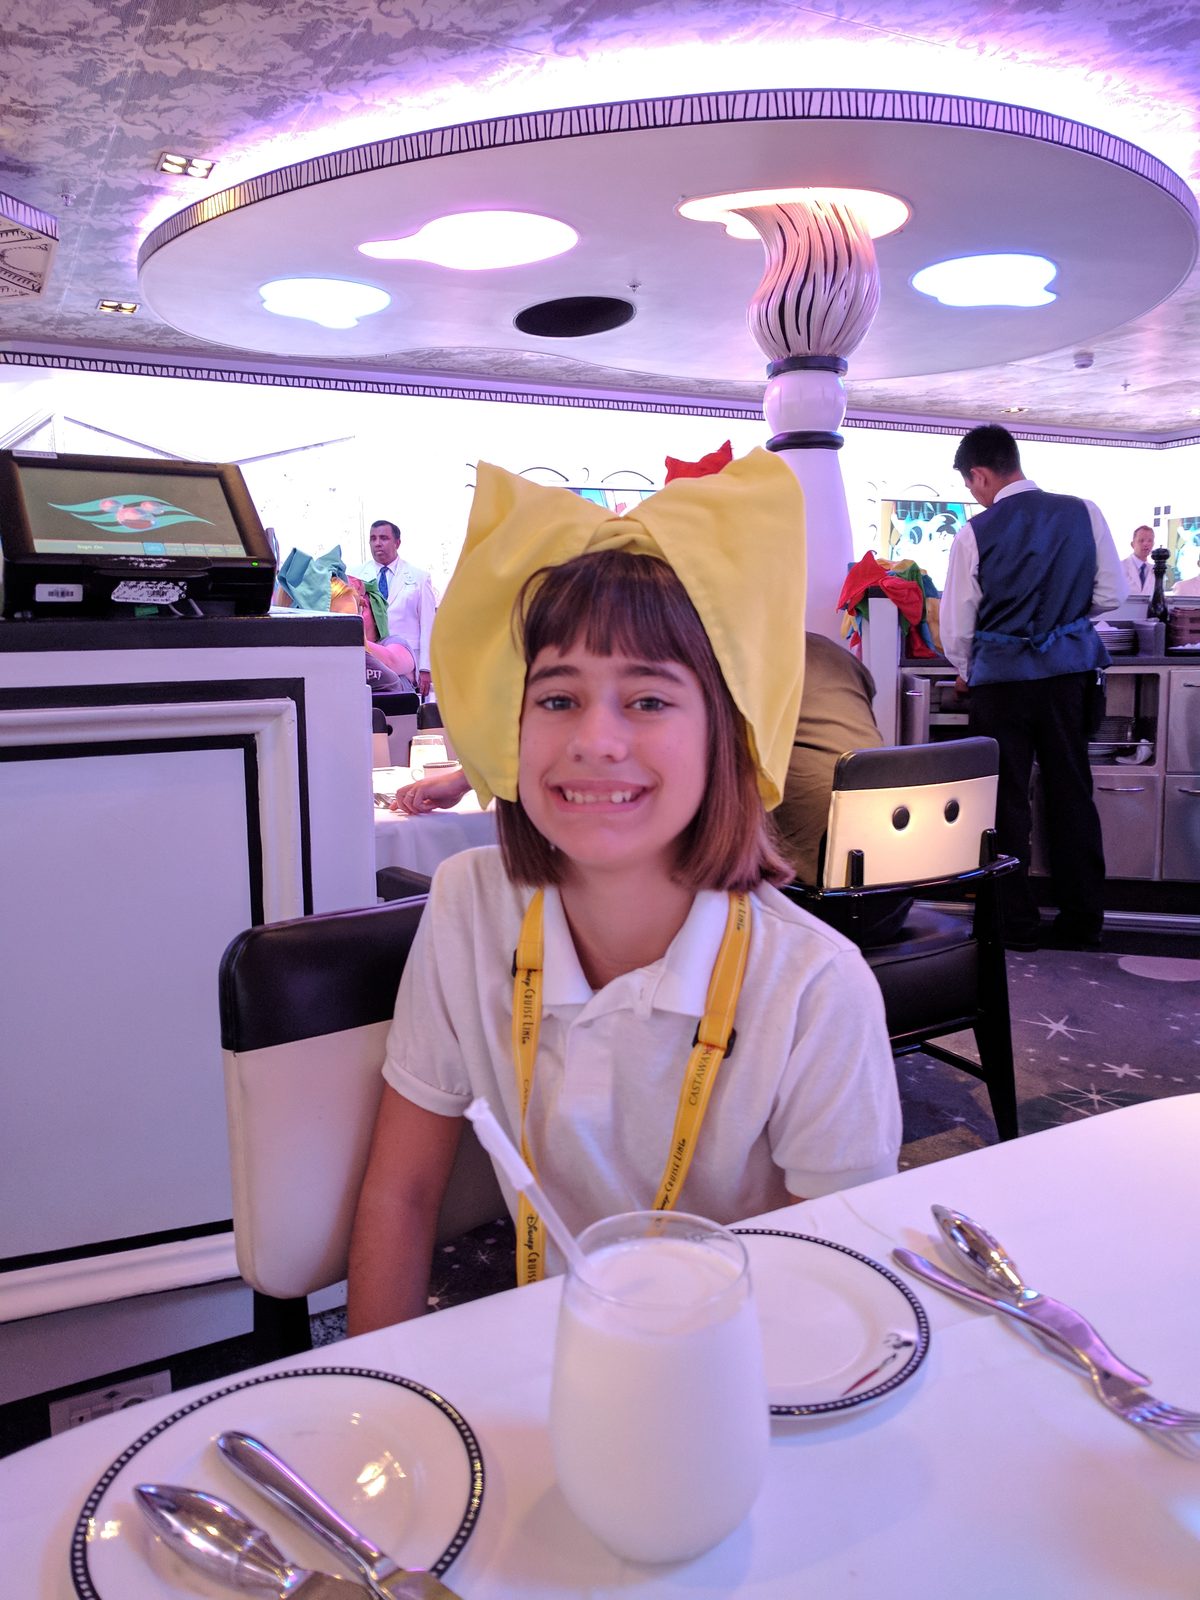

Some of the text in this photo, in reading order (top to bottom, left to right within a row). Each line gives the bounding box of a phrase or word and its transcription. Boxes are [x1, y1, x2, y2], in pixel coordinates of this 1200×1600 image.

[523, 988, 536, 1018] CRUISE
[664, 1162, 680, 1192] CRUISE
[524, 1213, 539, 1250] Disney
